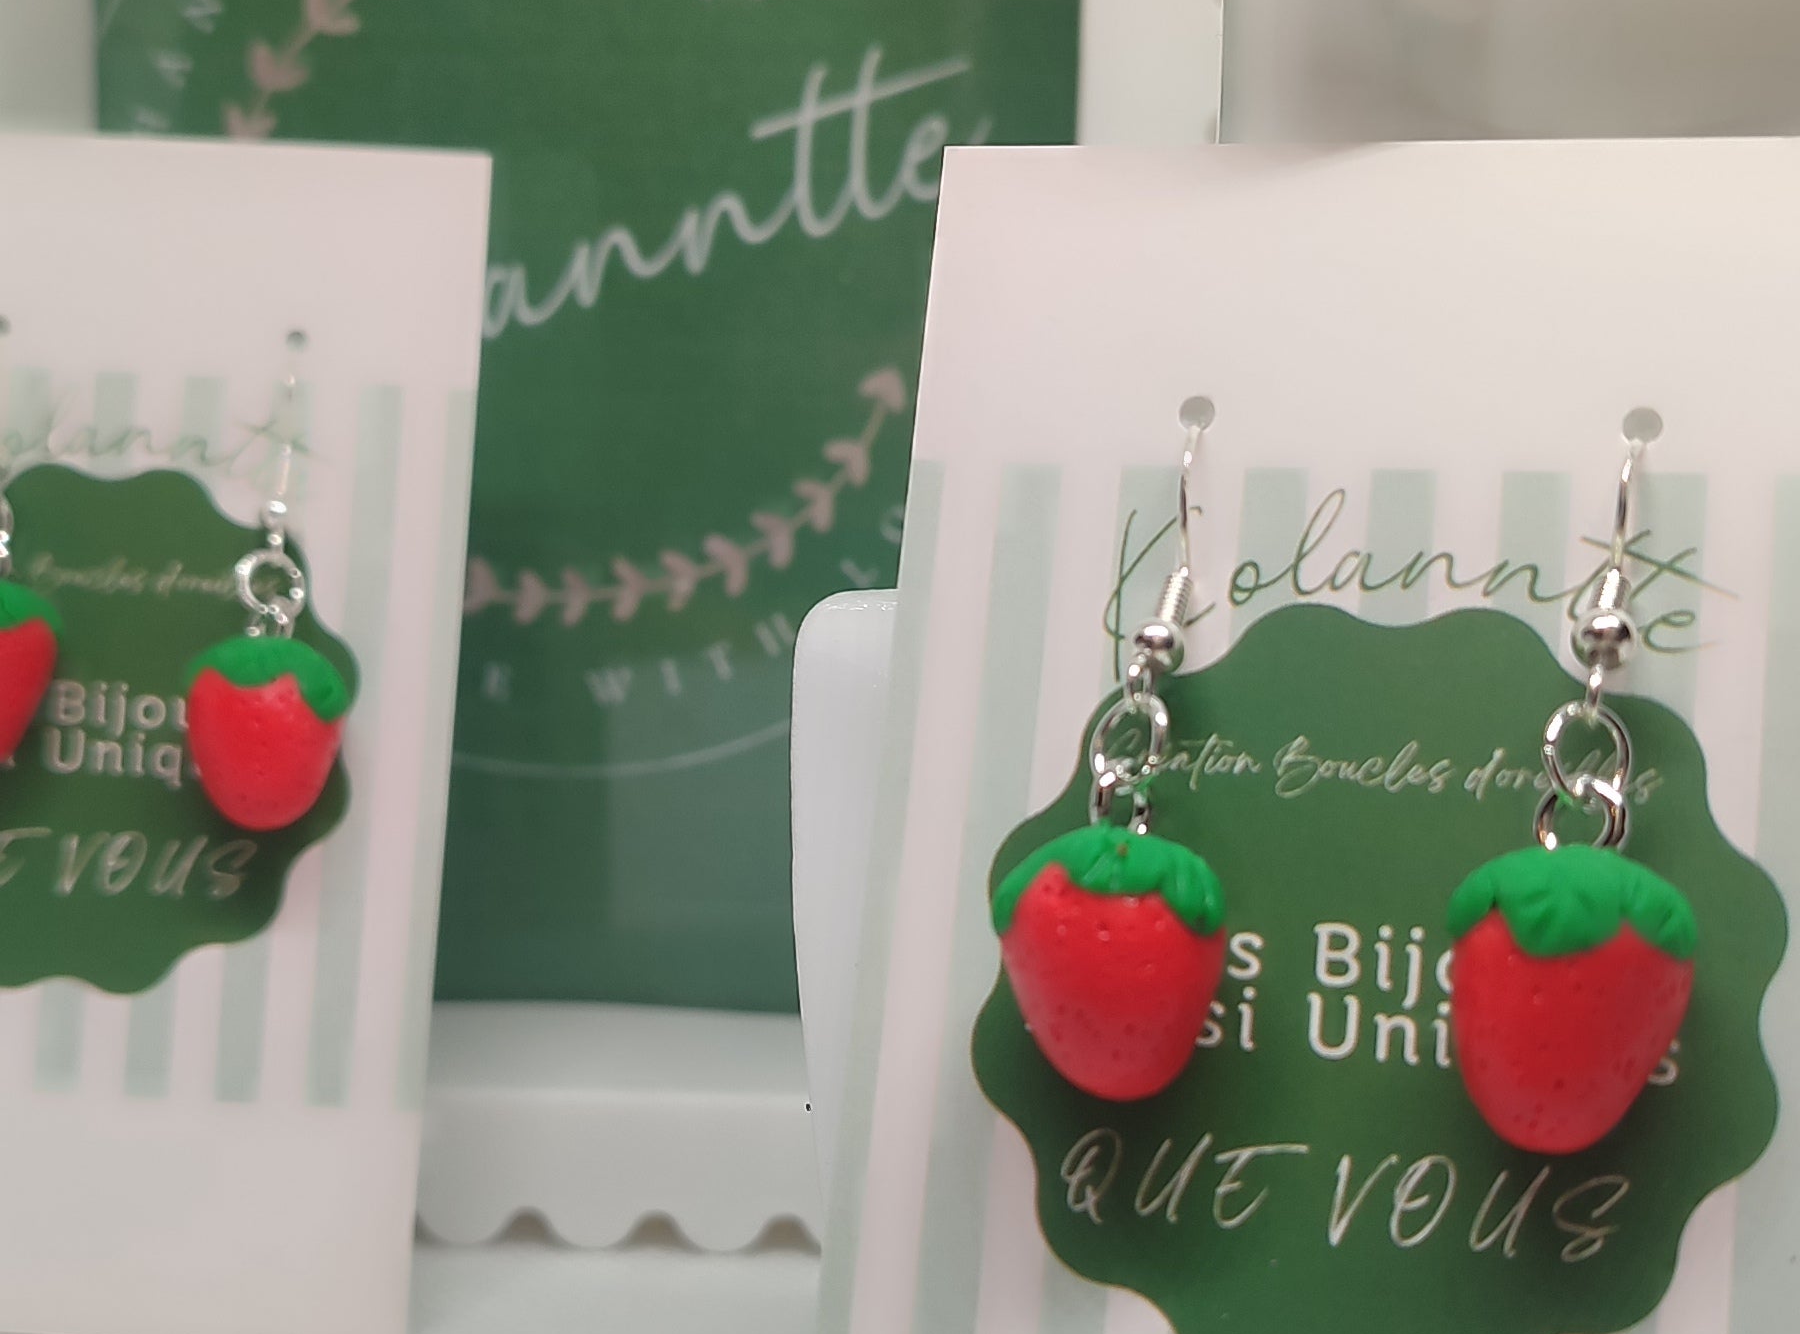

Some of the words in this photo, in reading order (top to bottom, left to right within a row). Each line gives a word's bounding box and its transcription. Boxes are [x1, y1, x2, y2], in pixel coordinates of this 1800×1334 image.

[50, 678, 190, 739] Bijo
[44, 727, 204, 790] Uniq
[1273, 735, 1453, 798] Boucles
[56, 829, 259, 901] VOUS
[1313, 921, 1456, 1010] Bij
[1061, 1127, 1309, 1228] QUE
[1328, 1155, 1632, 1264] VOUS
